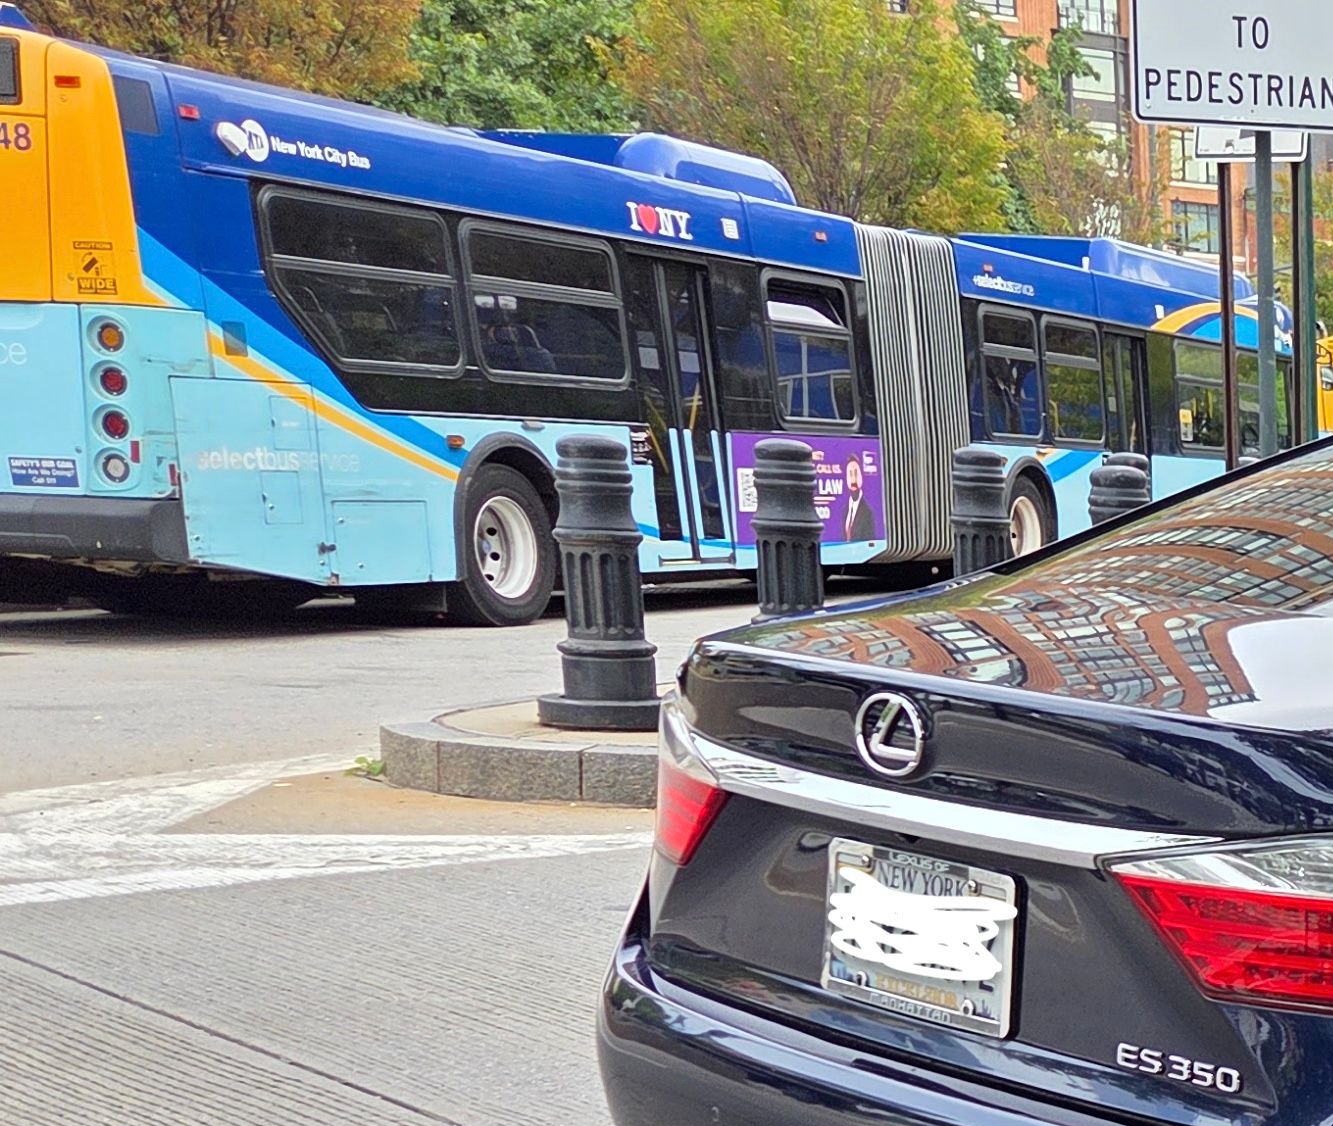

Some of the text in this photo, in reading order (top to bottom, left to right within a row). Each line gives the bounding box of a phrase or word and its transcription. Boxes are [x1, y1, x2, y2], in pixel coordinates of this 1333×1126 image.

[1232, 15, 1269, 50] TO
[270, 135, 371, 170] New York City Bus
[79, 278, 116, 291] WIDE
[818, 479, 843, 495] LAW
[876, 860, 967, 898] NEW YORK
[888, 851, 949, 873] LEXUS OF
[1116, 1042, 1241, 1093] ES 350
